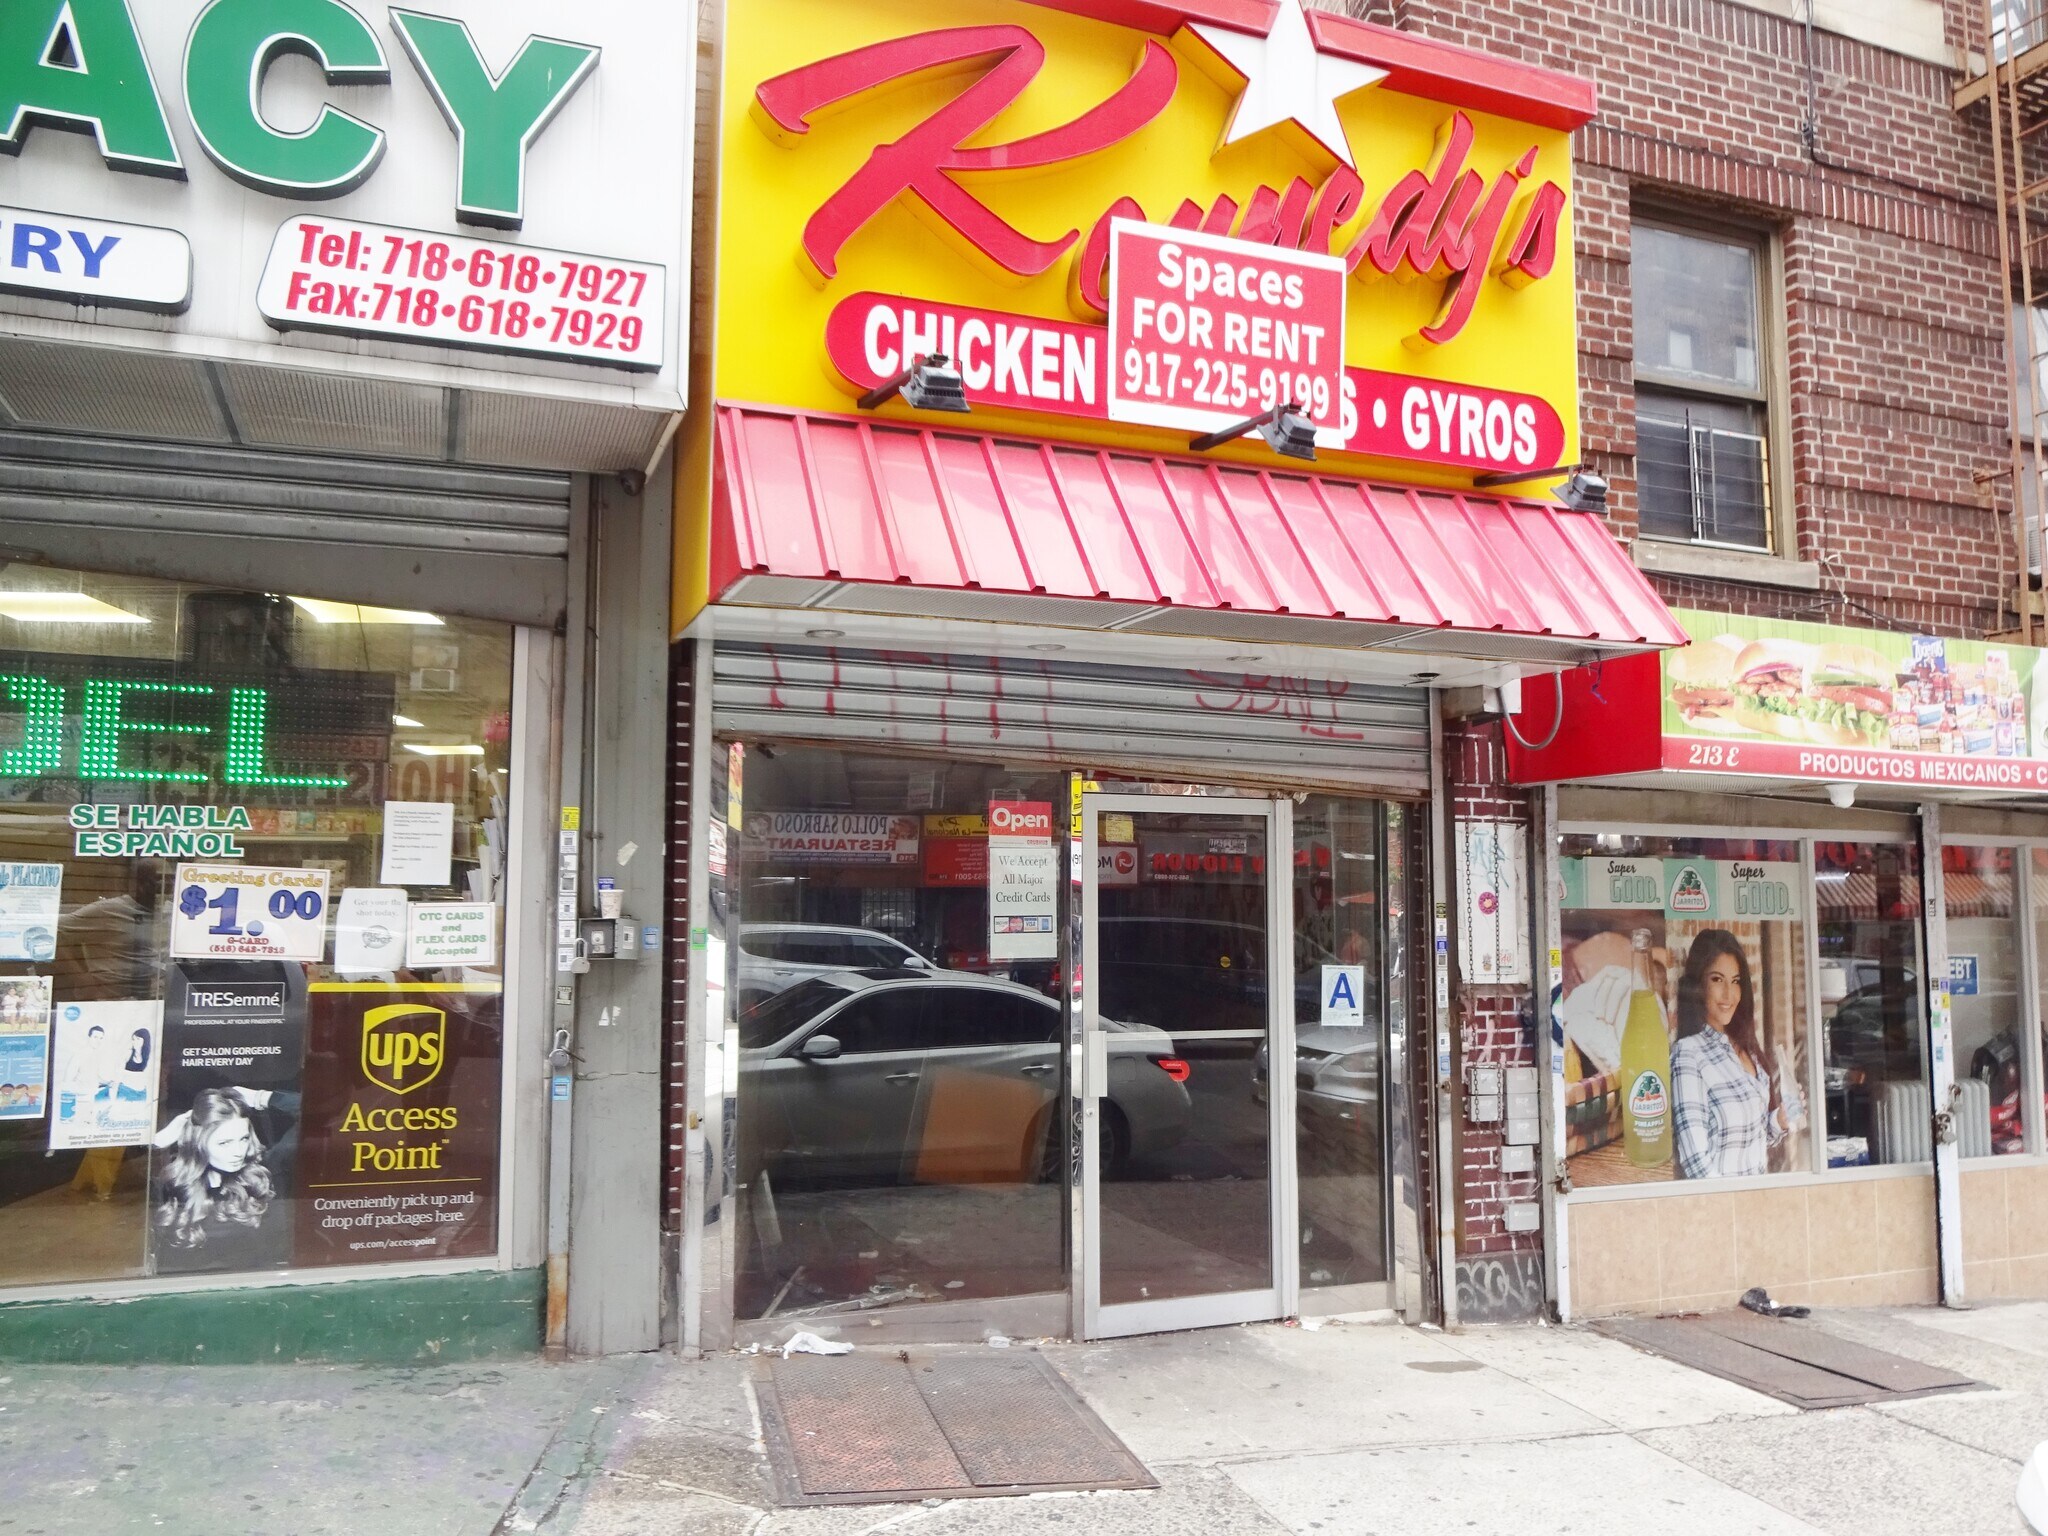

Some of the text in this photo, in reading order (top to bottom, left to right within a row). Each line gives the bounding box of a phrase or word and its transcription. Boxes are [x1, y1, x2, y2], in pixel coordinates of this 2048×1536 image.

[11, 222, 122, 280] RY
[299, 224, 371, 271] Tel:
[1157, 242, 1304, 309] Spaces
[1133, 297, 1325, 366] FOR RENT
[864, 303, 1096, 405] CHICKEN
[1402, 386, 1538, 465] GYROS
[1123, 347, 1330, 421] 917-225-9199
[1688, 744, 1724, 767] 213
[1800, 751, 1915, 779] PRODUCTOS
[1920, 757, 2021, 784] MEXICANOS
[71, 804, 251, 830] SE HABLA
[992, 807, 1049, 831] Open
[77, 828, 245, 857] ESPAÑOL
[998, 855, 1017, 867] We
[1019, 855, 1048, 868] Accept
[1607, 860, 1637, 877] Super
[183, 868, 324, 888] Greeting Cards
[1002, 874, 1044, 887] All Major
[1730, 862, 1766, 882] Super
[353, 898, 369, 906] Get
[371, 899, 389, 908] your
[995, 891, 1051, 903] Credit Cards
[419, 912, 484, 921] OTC CARDS
[441, 923, 462, 932] and
[227, 937, 270, 945] G-CARD
[416, 934, 487, 944] FLEX CARDS
[424, 946, 478, 956] Accepted
[1949, 958, 1972, 980] EBT
[191, 991, 280, 1007] TRESemmé
[1328, 972, 1356, 1009] A
[182, 1046, 282, 1056] GET SALON GORGEOUS
[368, 1032, 440, 1081] ups
[182, 1057, 254, 1067] HAIR EVERY DAY
[339, 1102, 458, 1132] Access
[314, 1191, 474, 1211] Conveniently pick up and
[322, 1210, 466, 1229] drop off packages here.
[350, 1237, 436, 1251] ups.com/accesspoint
